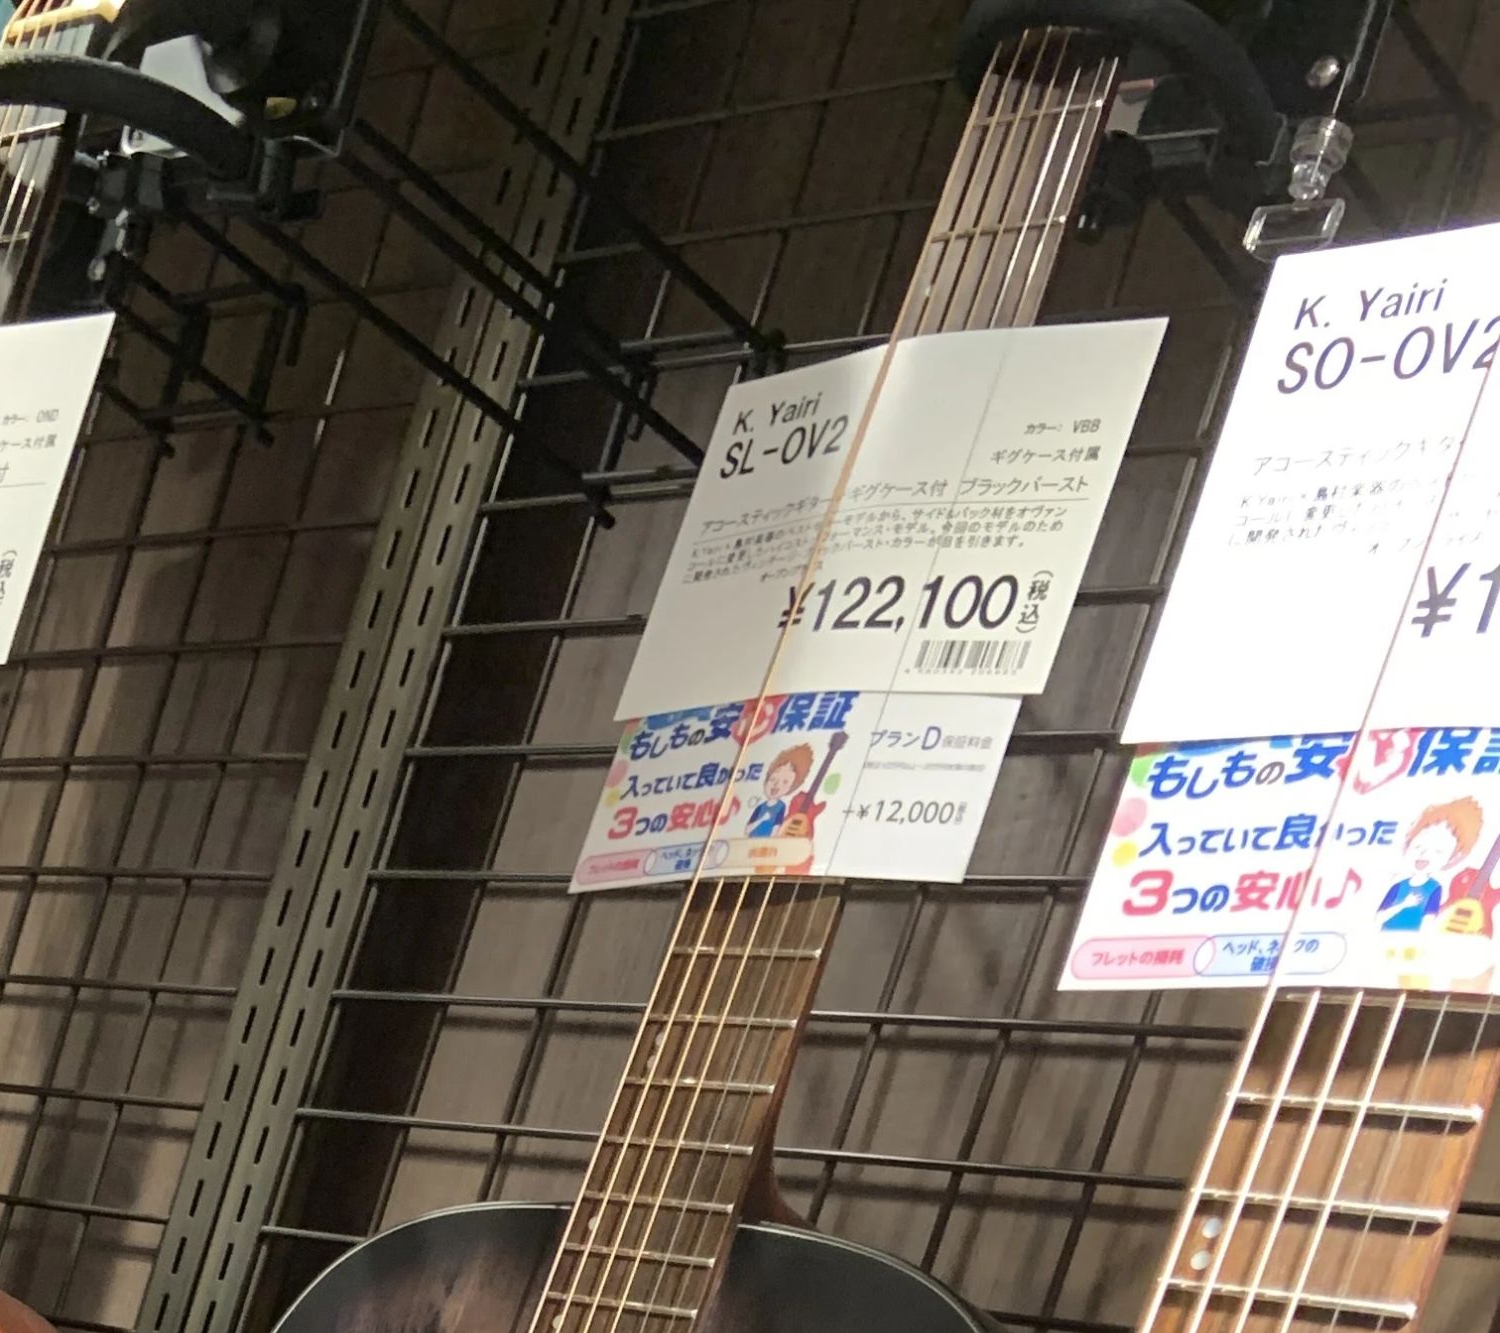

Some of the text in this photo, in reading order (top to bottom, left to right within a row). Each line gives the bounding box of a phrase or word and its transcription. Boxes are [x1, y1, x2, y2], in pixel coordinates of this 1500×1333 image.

[1293, 278, 1449, 332] K. Yairi
[768, 391, 824, 427] Yairi
[719, 414, 850, 480] SL-OV2
[776, 573, 1019, 635] ¥122,100
